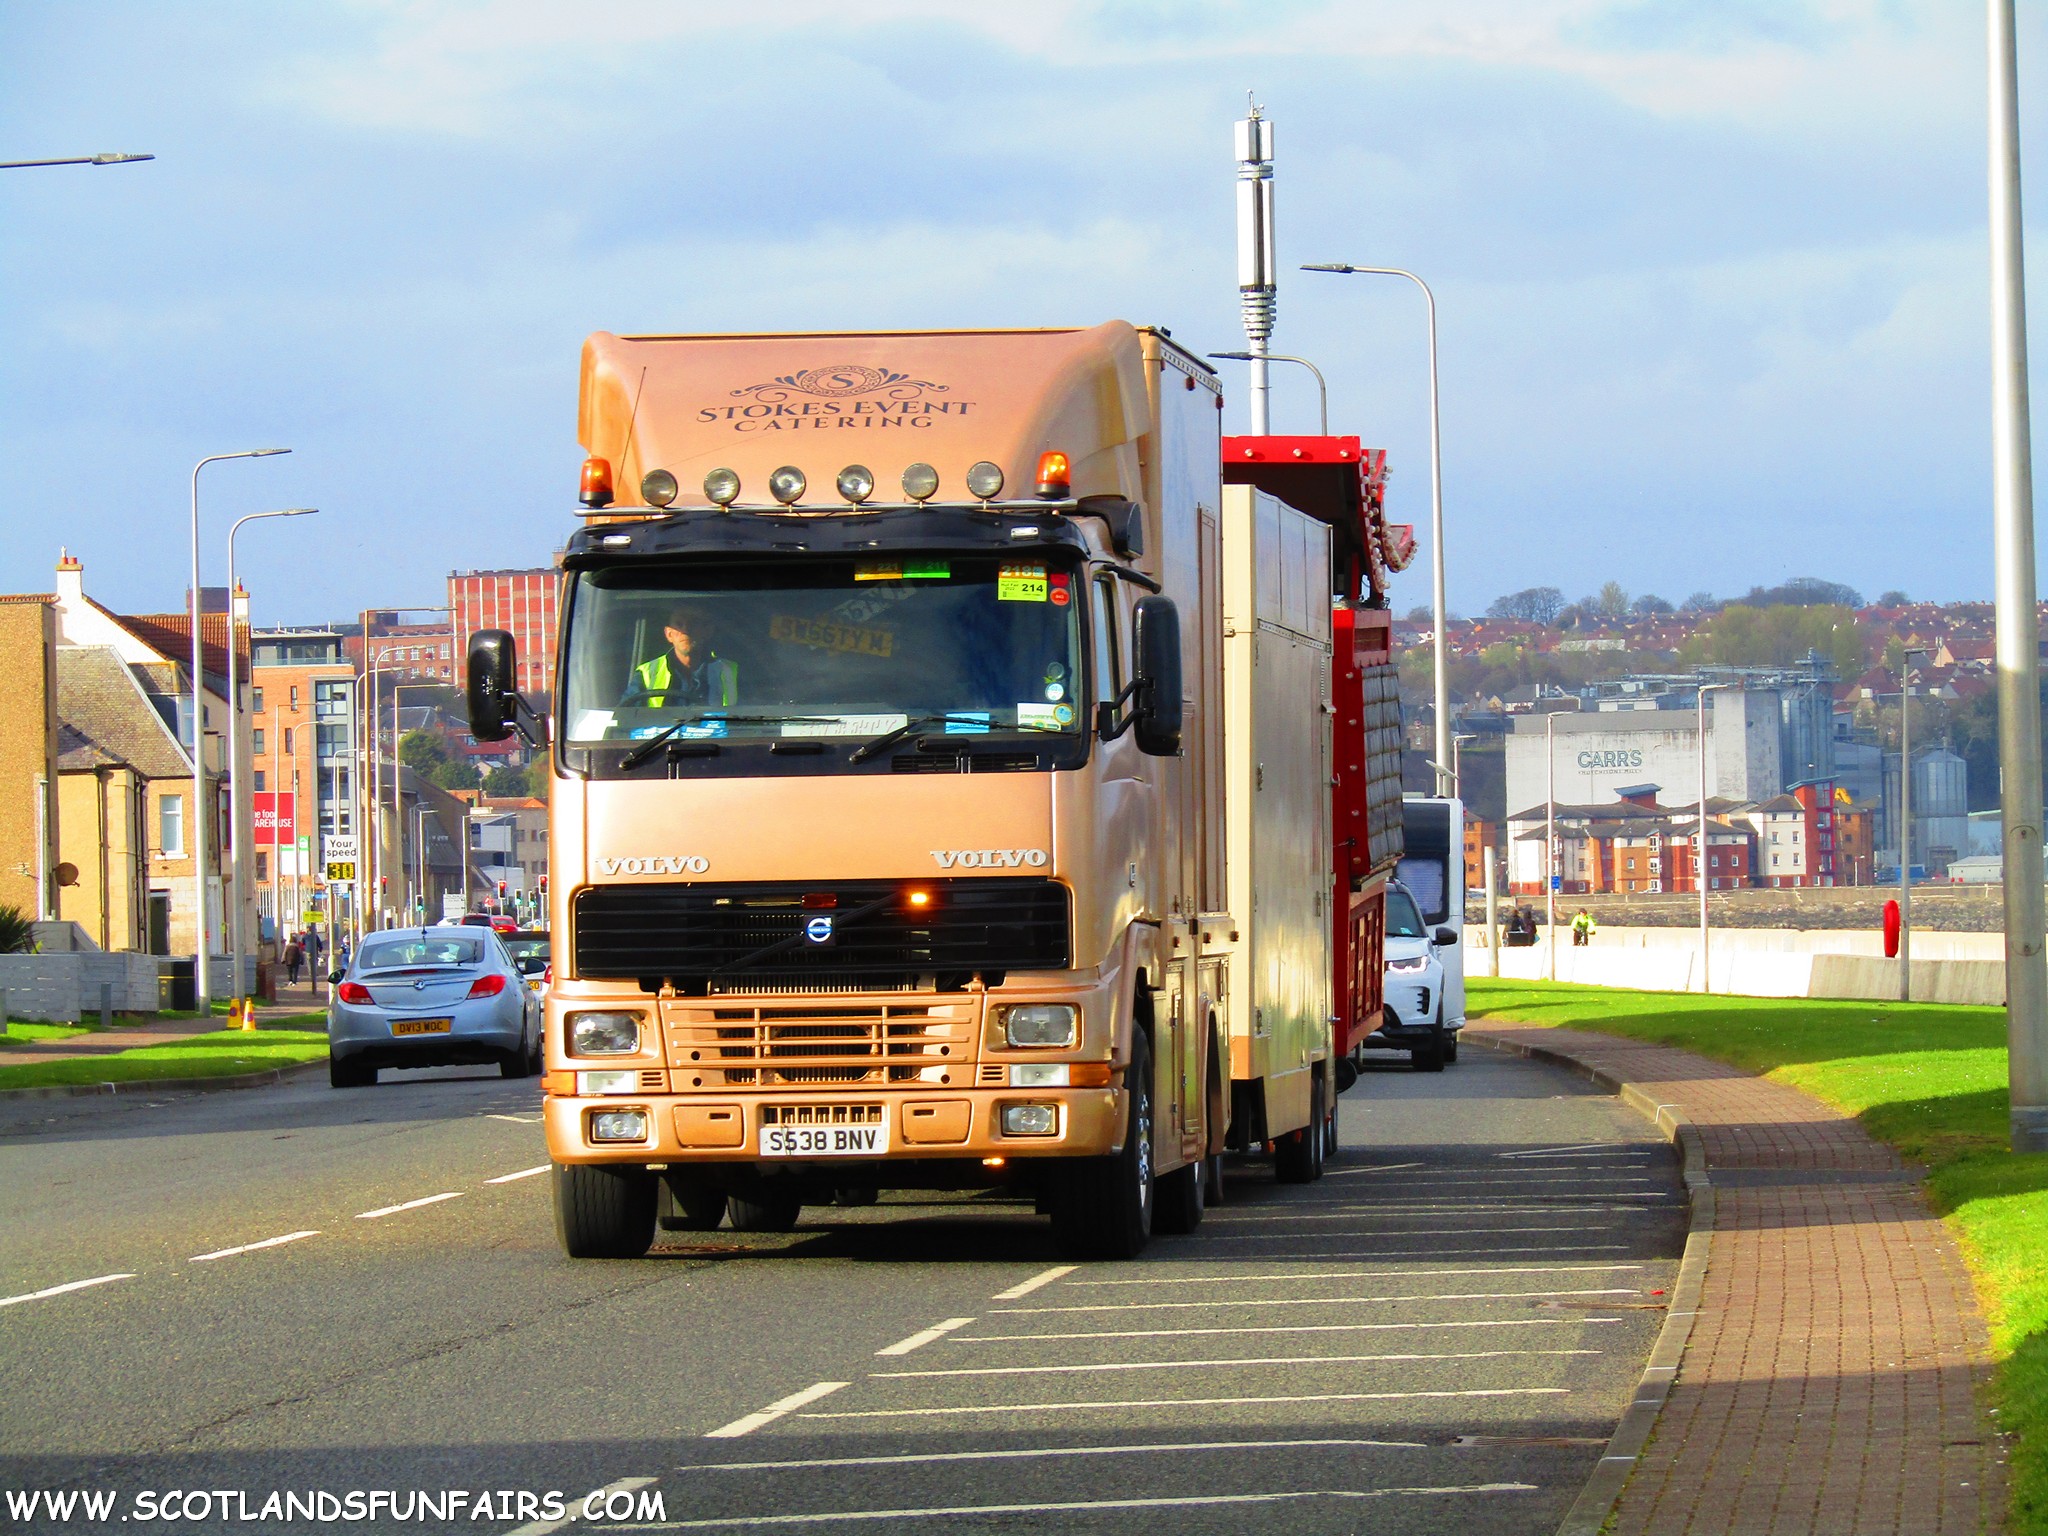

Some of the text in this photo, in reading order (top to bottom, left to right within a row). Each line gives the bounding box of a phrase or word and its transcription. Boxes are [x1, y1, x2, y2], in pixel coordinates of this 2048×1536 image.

[696, 401, 977, 423] STOKES EVENT
[734, 416, 932, 432] CATERING
[1022, 583, 1044, 592] 214
[330, 839, 353, 848] Your
[326, 848, 357, 858] speed
[929, 848, 1048, 869] VOLVO
[329, 862, 354, 880] 30
[595, 856, 710, 875] VOLVO
[769, 1129, 876, 1151] S538 BNV
